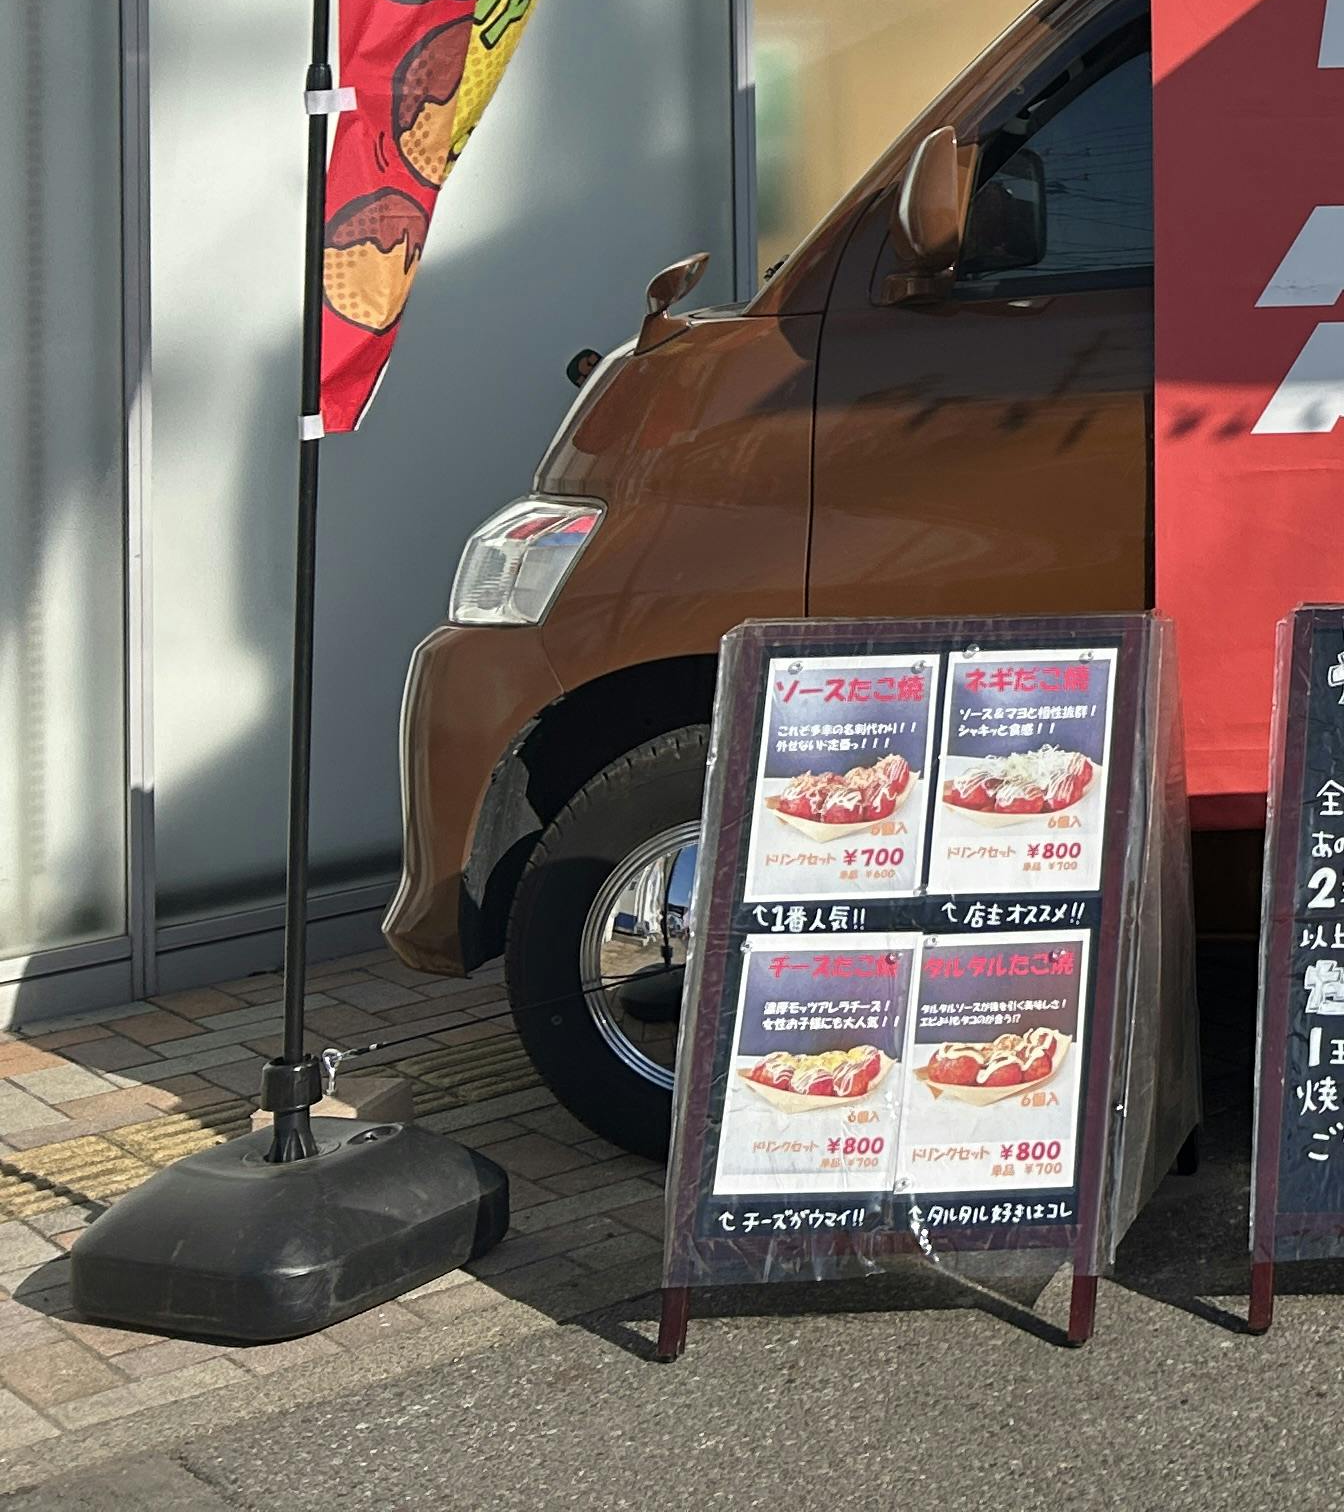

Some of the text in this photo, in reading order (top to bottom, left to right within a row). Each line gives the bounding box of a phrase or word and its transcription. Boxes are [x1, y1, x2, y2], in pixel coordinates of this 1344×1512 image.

[776, 675, 924, 703] ソースたこ焼
[842, 847, 905, 867] ¥700
[1026, 842, 1082, 860] ¥800
[771, 905, 866, 934] 1番人気!!
[963, 901, 1086, 929] 店主オススメ!!
[826, 1136, 885, 1156] ¥800
[1000, 1140, 1062, 1161] ¥800
[1023, 1162, 1063, 1176] ¥700
[742, 1208, 867, 1234] チーズがウマイ!!
[927, 1201, 1074, 1227] タルタル好きはコレ
